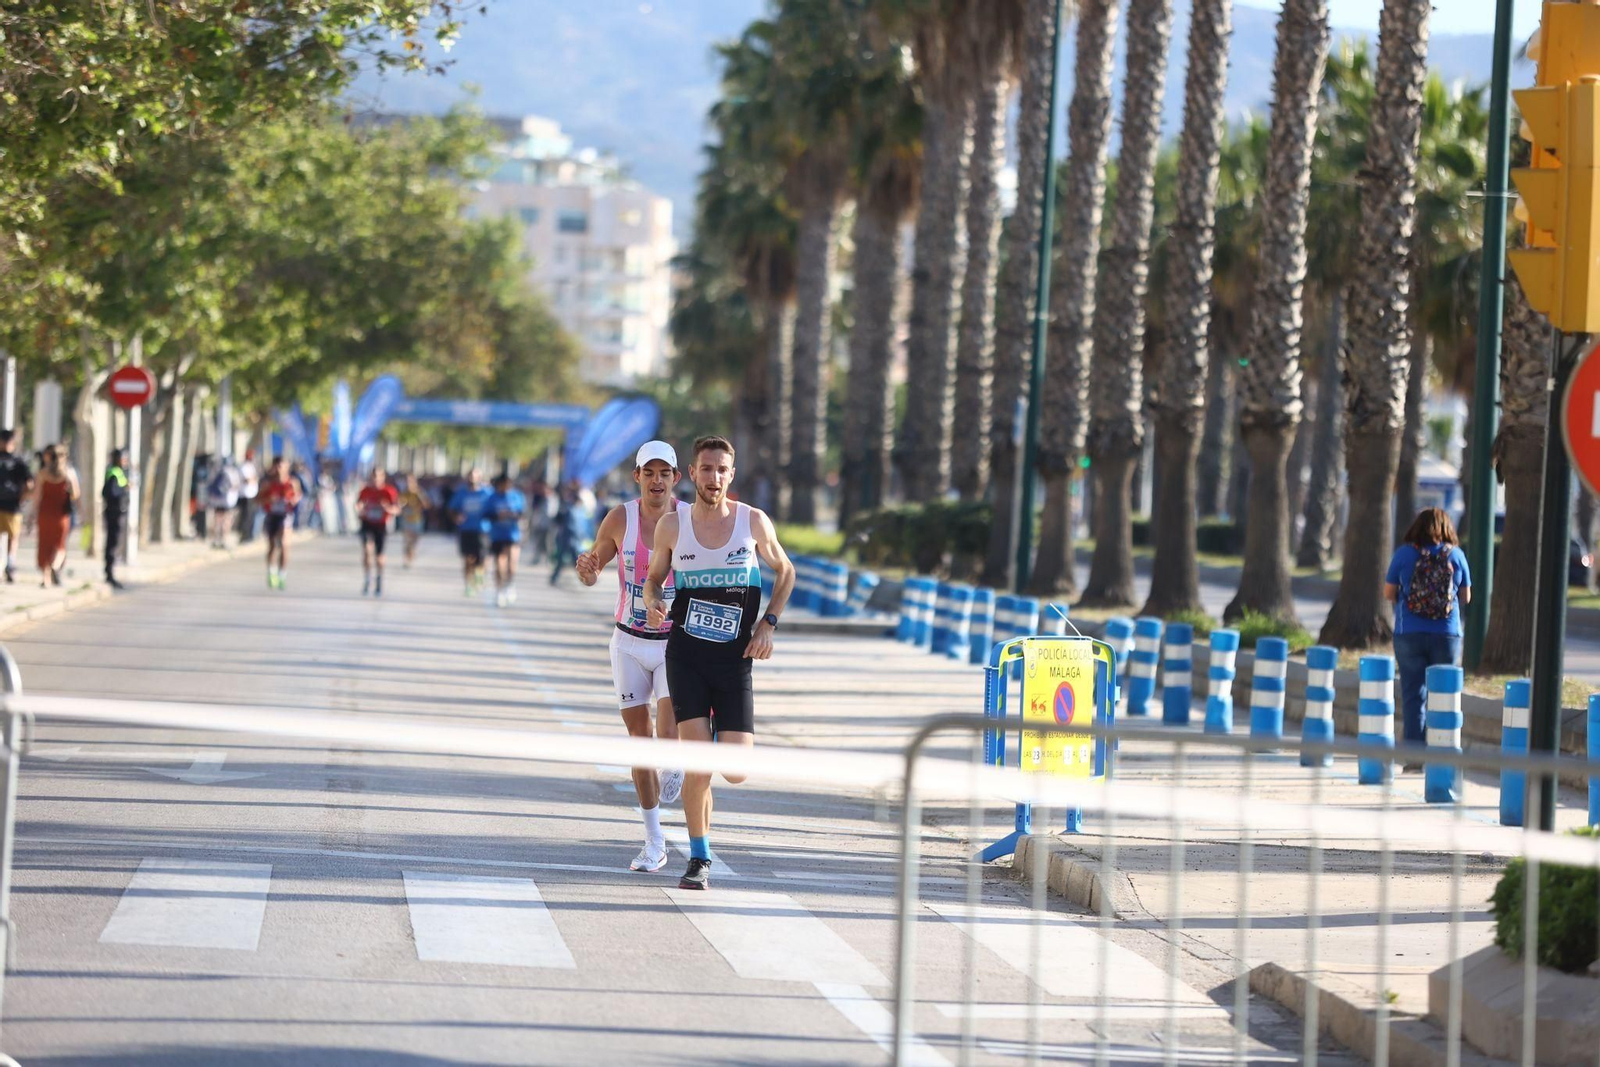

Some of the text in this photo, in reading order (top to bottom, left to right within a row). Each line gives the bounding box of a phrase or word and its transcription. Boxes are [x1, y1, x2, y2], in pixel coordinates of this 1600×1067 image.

[682, 573, 748, 588] inacua
[694, 614, 733, 632] 1992
[1038, 646, 1093, 661] POLICÍA LOCAL
[1049, 664, 1082, 678] MÁLAGA
